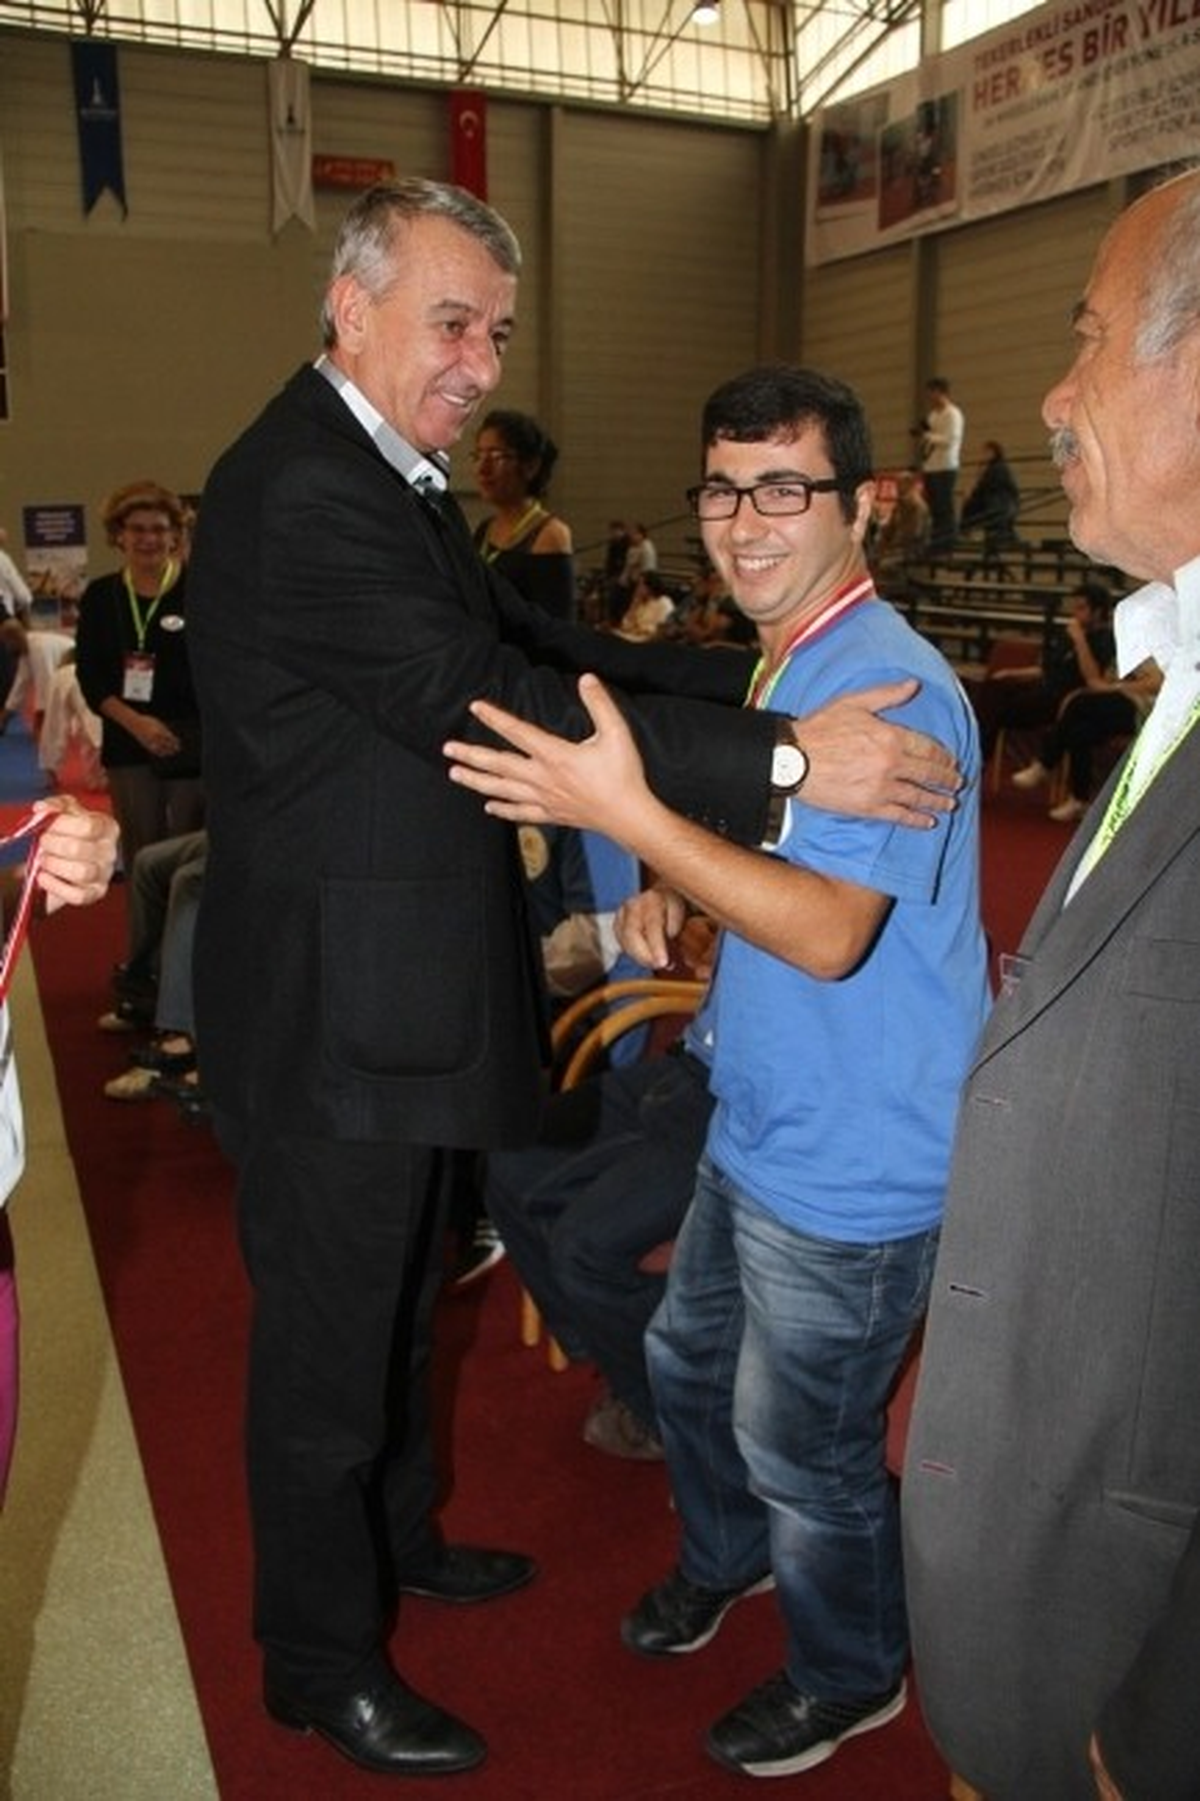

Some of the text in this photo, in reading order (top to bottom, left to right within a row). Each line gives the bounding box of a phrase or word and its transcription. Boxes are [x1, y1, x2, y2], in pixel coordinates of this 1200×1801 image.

[973, 40, 1074, 111] HERES
[1082, 13, 1128, 67] BİR
[1138, 0, 1200, 40] YIL
